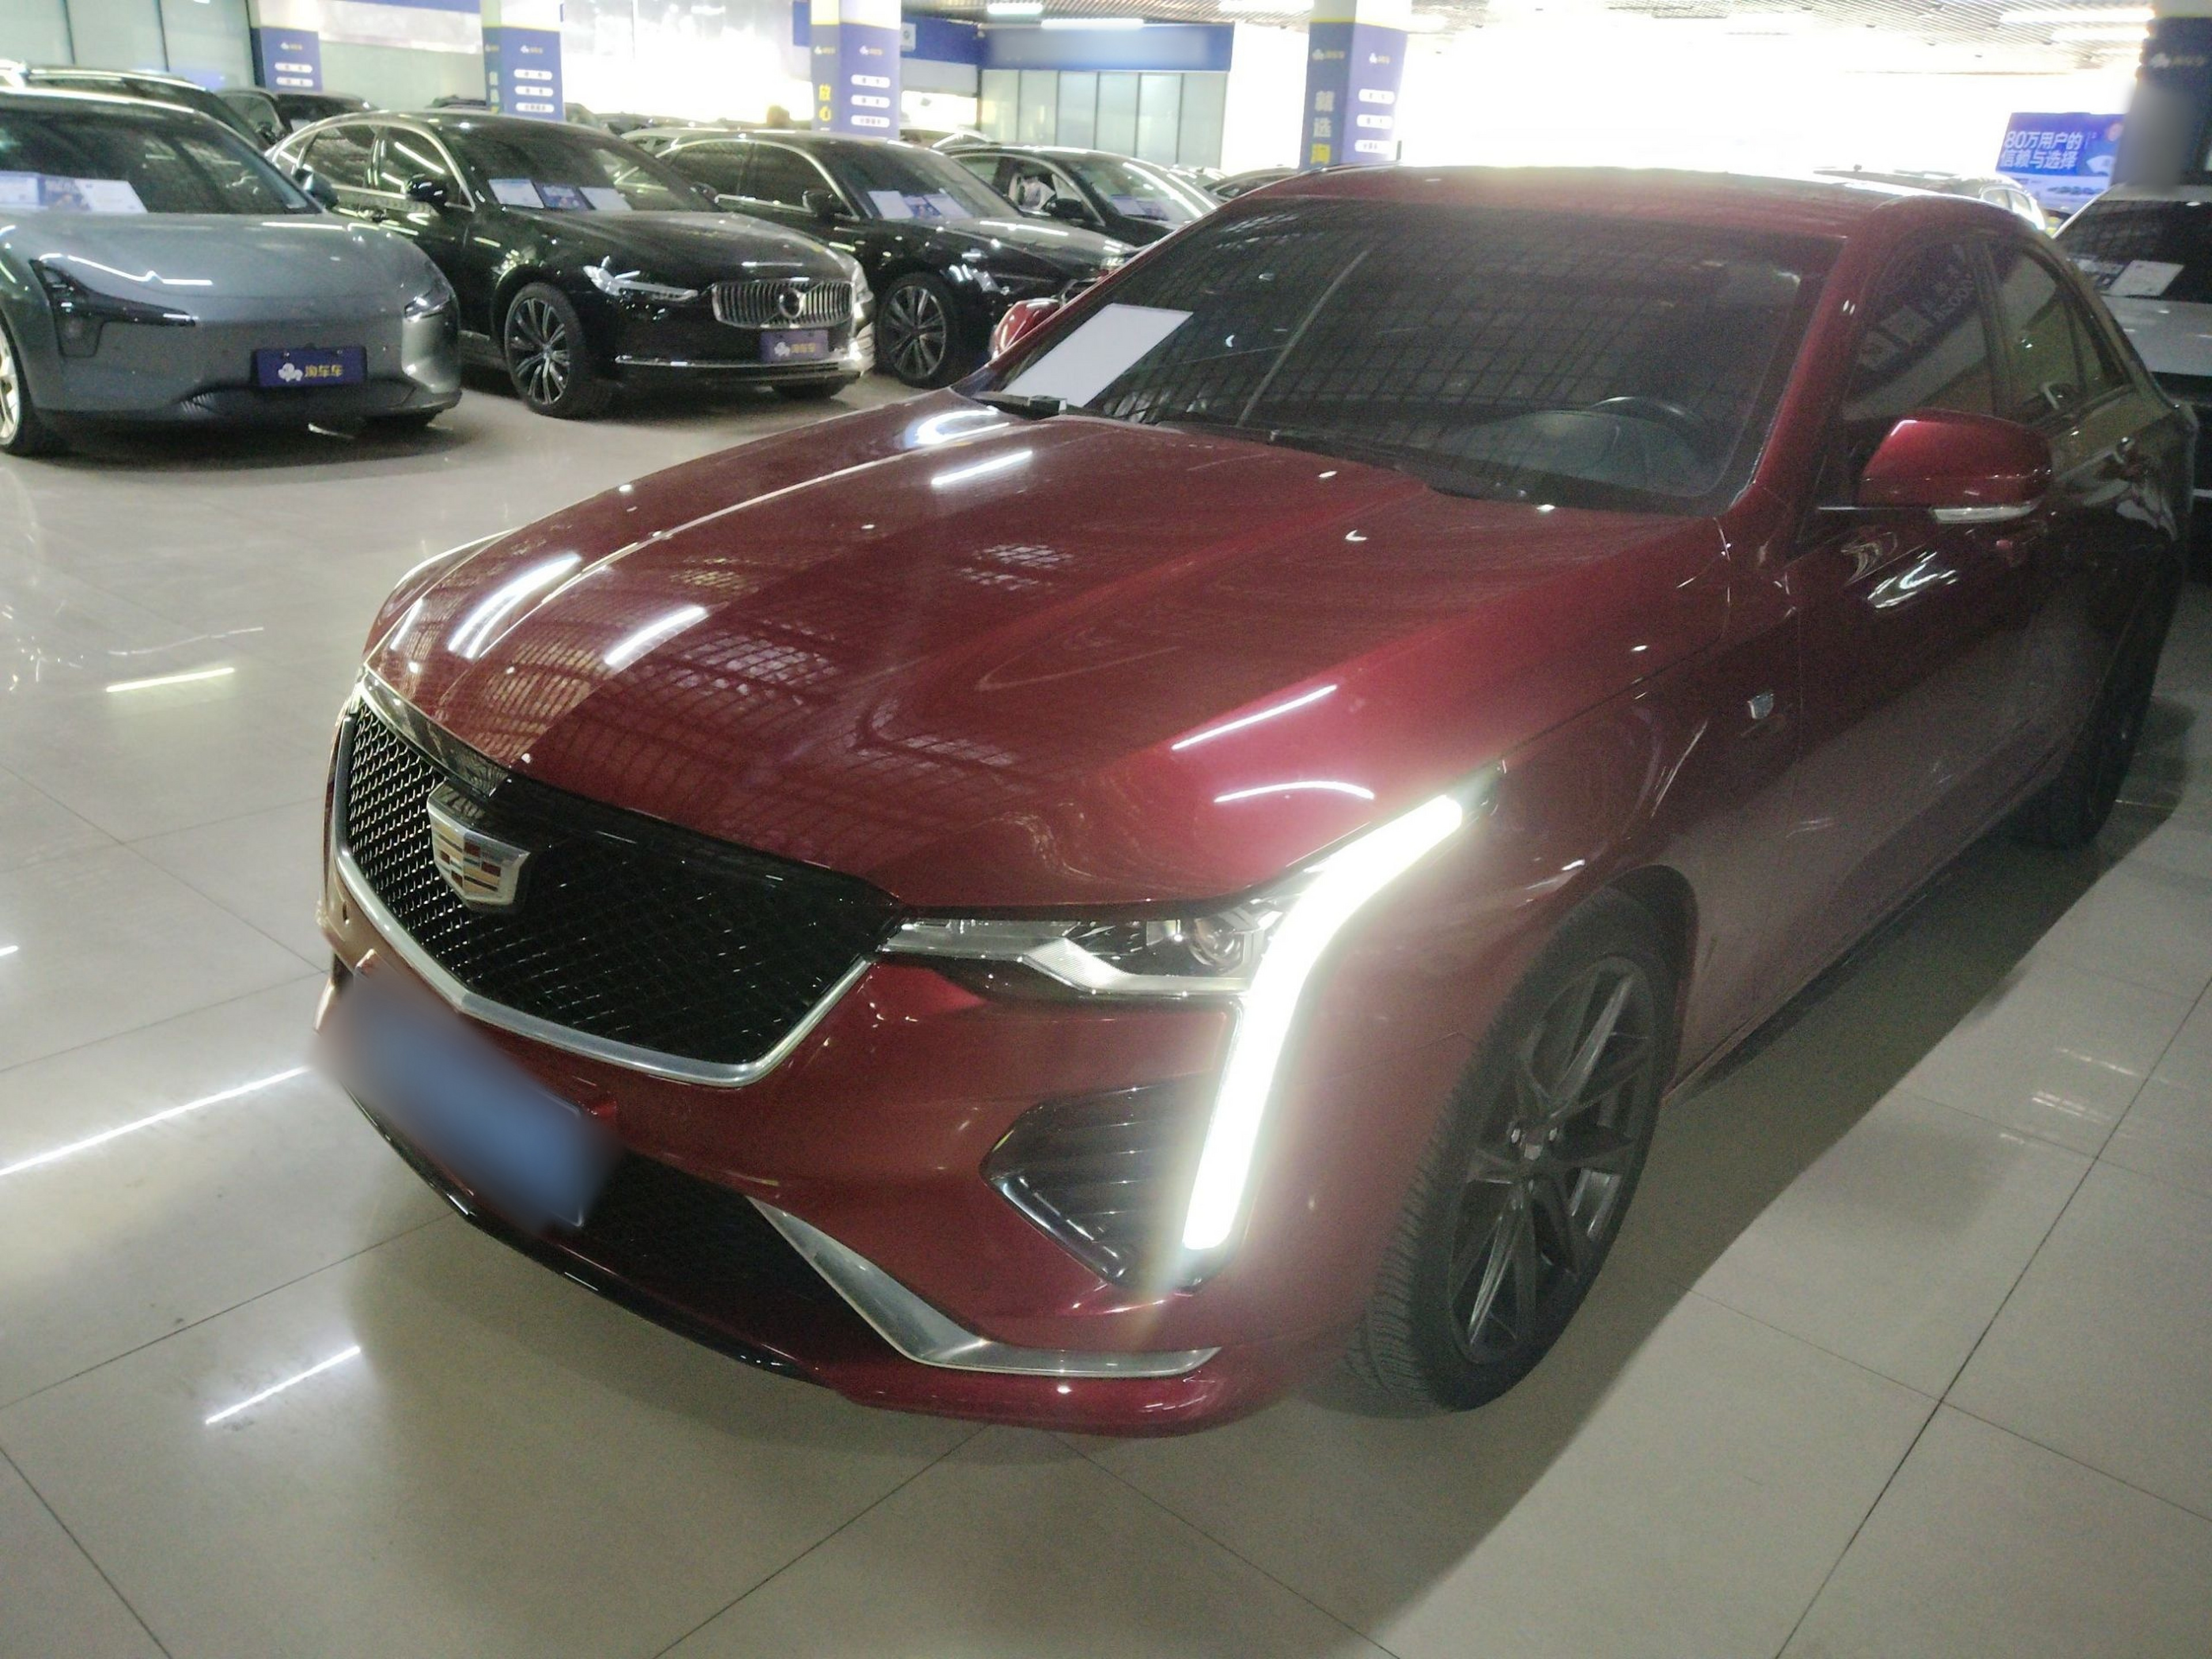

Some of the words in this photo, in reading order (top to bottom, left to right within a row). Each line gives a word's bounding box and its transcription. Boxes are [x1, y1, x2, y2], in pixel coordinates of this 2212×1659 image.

[2005, 131, 2082, 151] 80万用户的
[2001, 150, 2078, 169] 信赖与选择
